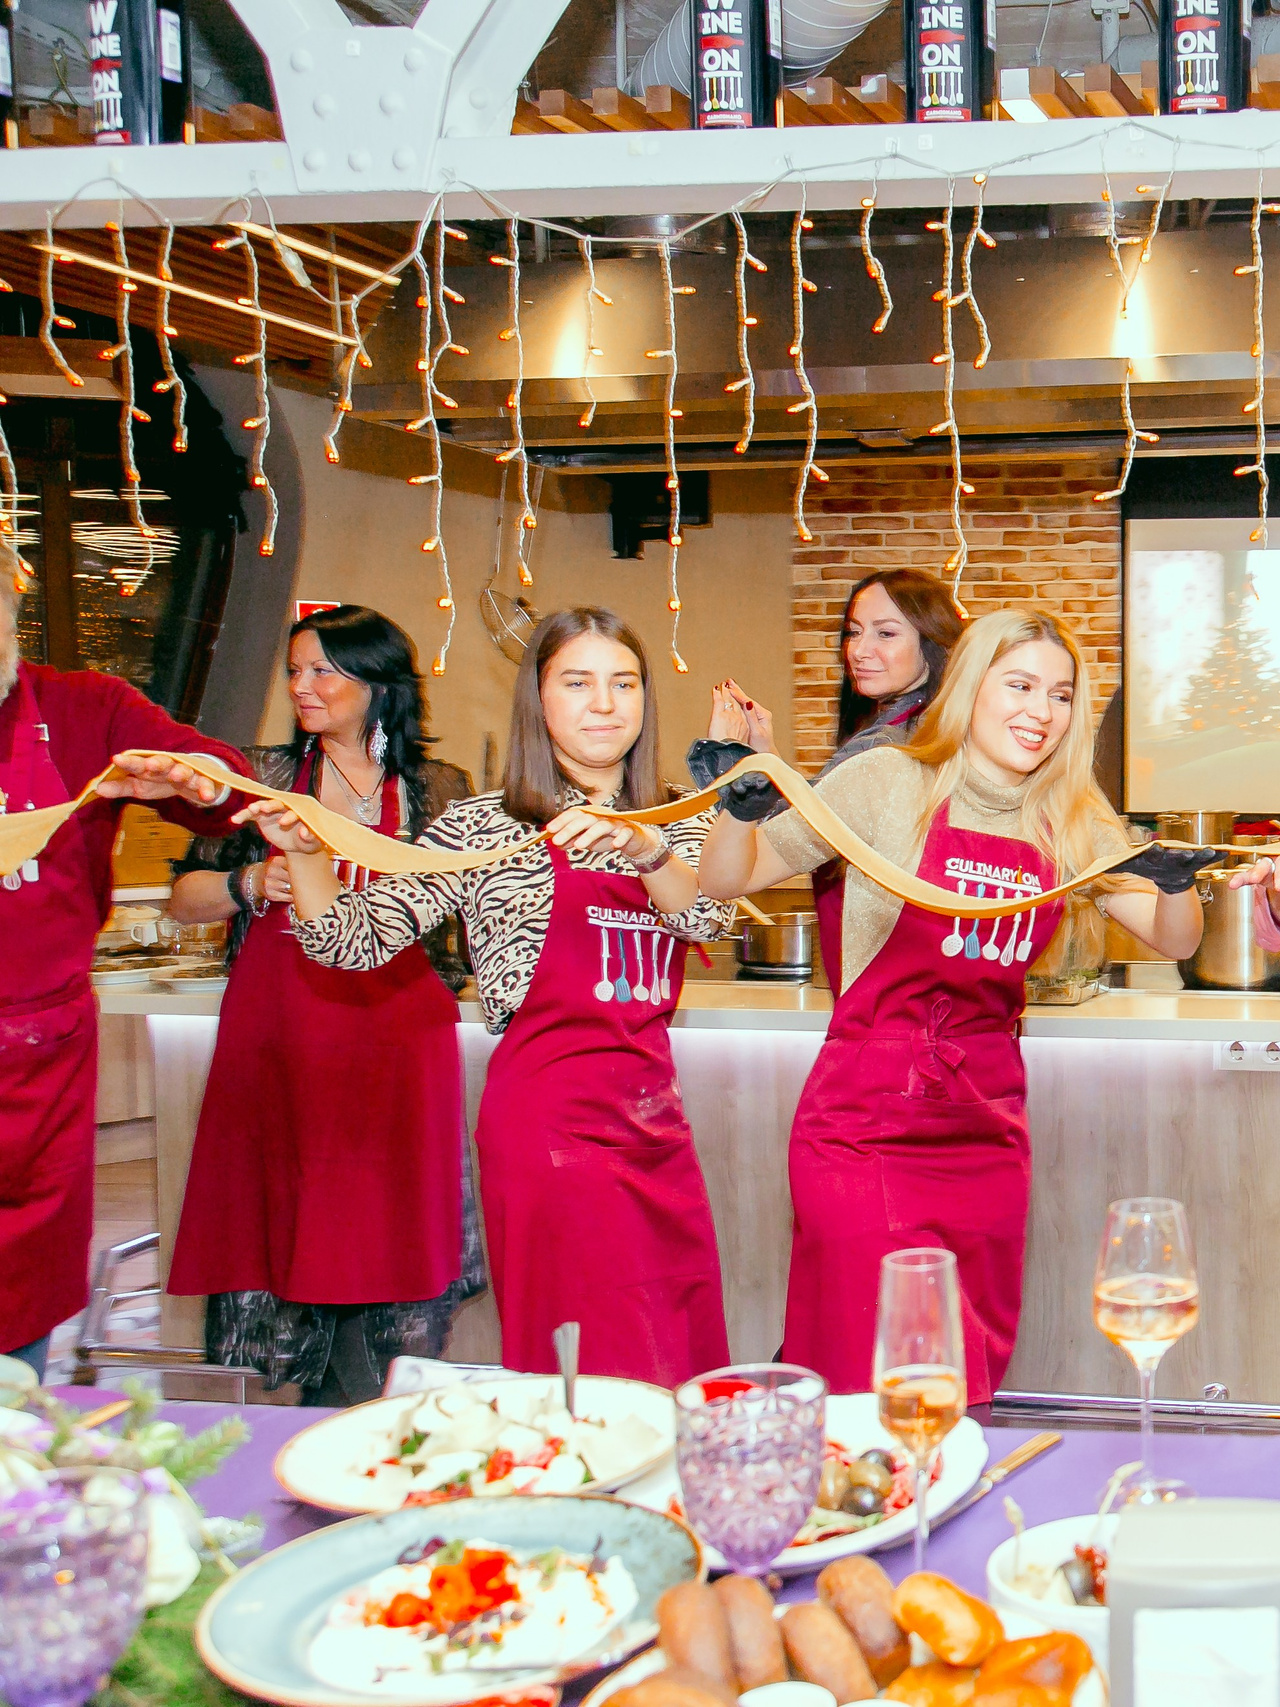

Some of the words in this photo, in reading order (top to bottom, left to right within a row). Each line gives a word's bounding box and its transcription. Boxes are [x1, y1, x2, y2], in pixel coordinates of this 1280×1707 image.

[702, 12, 743, 35] INE
[921, 6, 964, 29] INE
[1177, 30, 1216, 54] ON
[703, 48, 740, 71] ON
[922, 43, 960, 66] ON
[92, 69, 120, 94] ON
